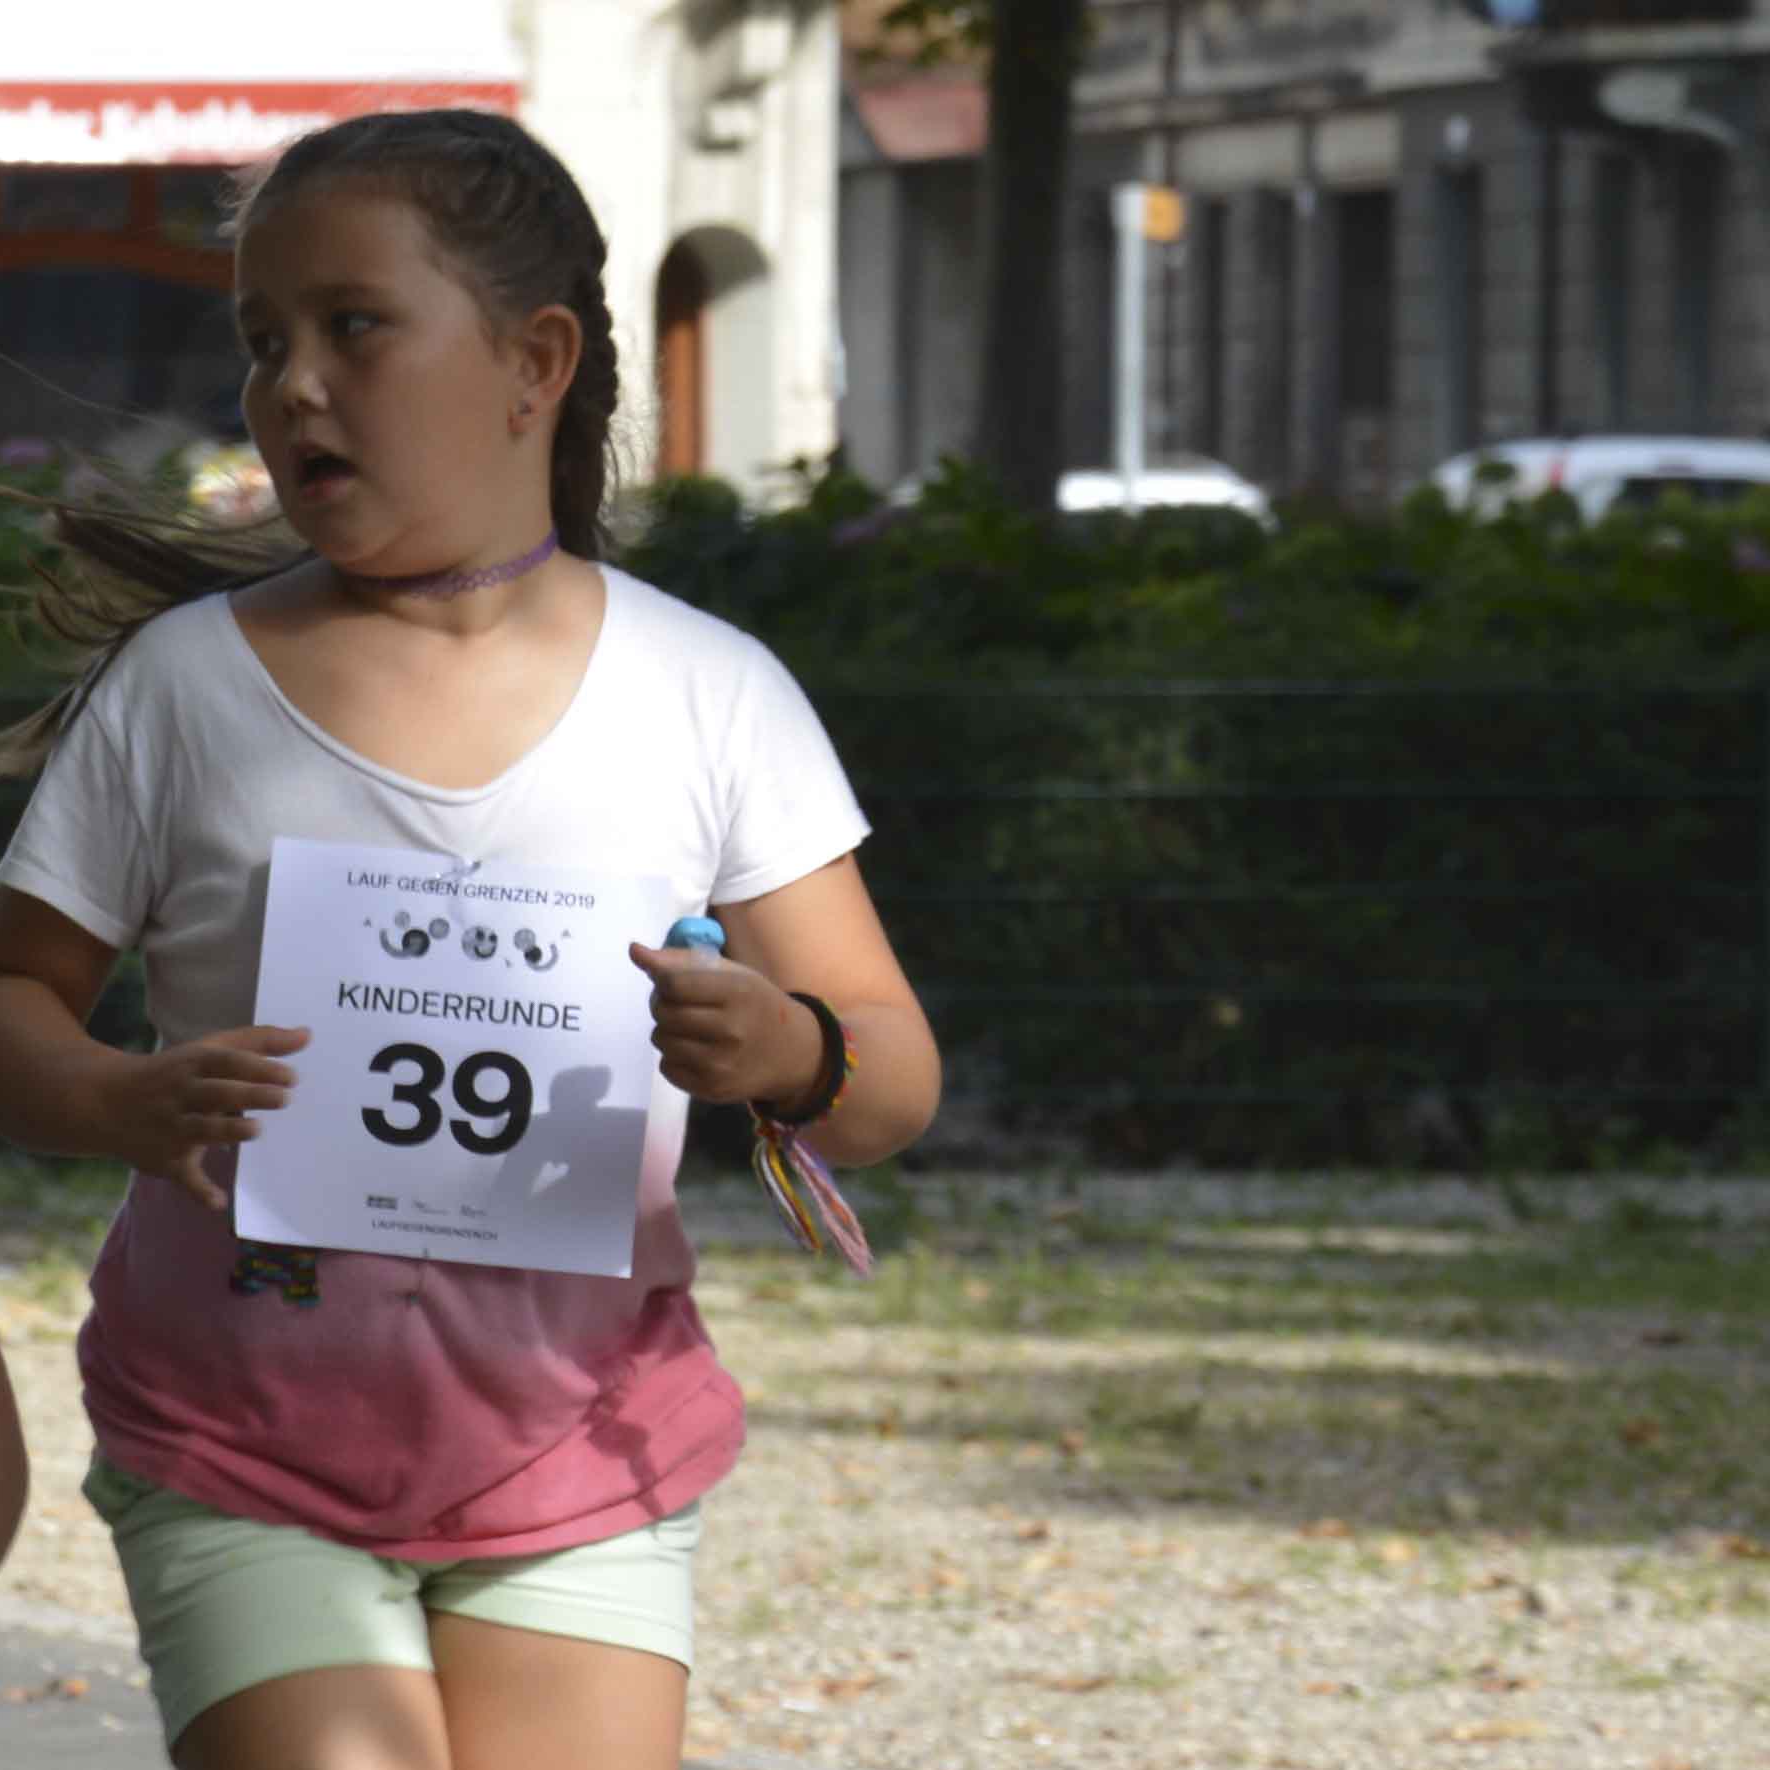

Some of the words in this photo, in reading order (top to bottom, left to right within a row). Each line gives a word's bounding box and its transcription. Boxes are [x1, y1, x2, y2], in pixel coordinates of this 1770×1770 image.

[346, 871, 392, 890] LAUF
[396, 876, 459, 898] GEGEN
[463, 884, 549, 906] GRENZEN
[553, 892, 596, 909] 2019
[337, 981, 582, 1032] KINDERRUNDE
[360, 1041, 534, 1156] 39
